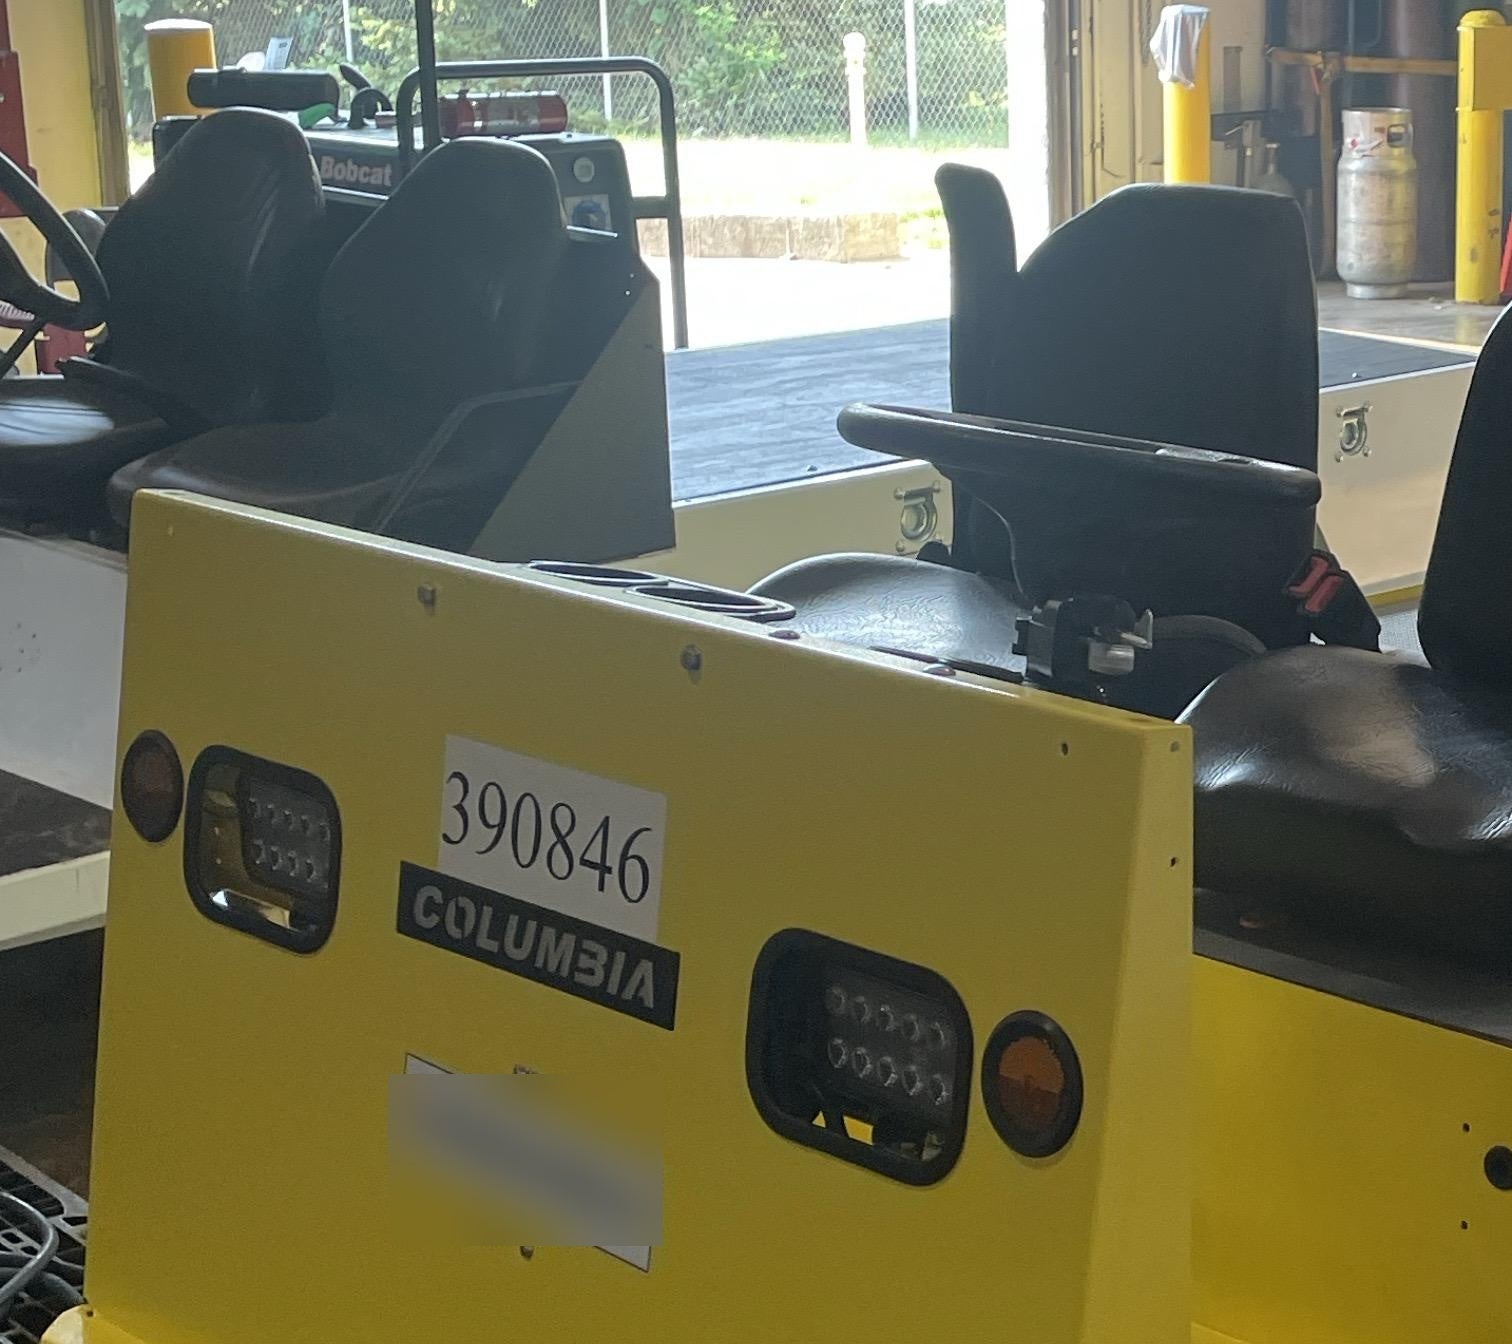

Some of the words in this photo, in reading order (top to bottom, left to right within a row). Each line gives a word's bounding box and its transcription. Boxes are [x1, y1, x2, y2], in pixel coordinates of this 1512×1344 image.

[320, 156, 392, 187] Bobcat
[442, 771, 653, 903] 390846
[413, 885, 655, 1009] COLUMBIA
